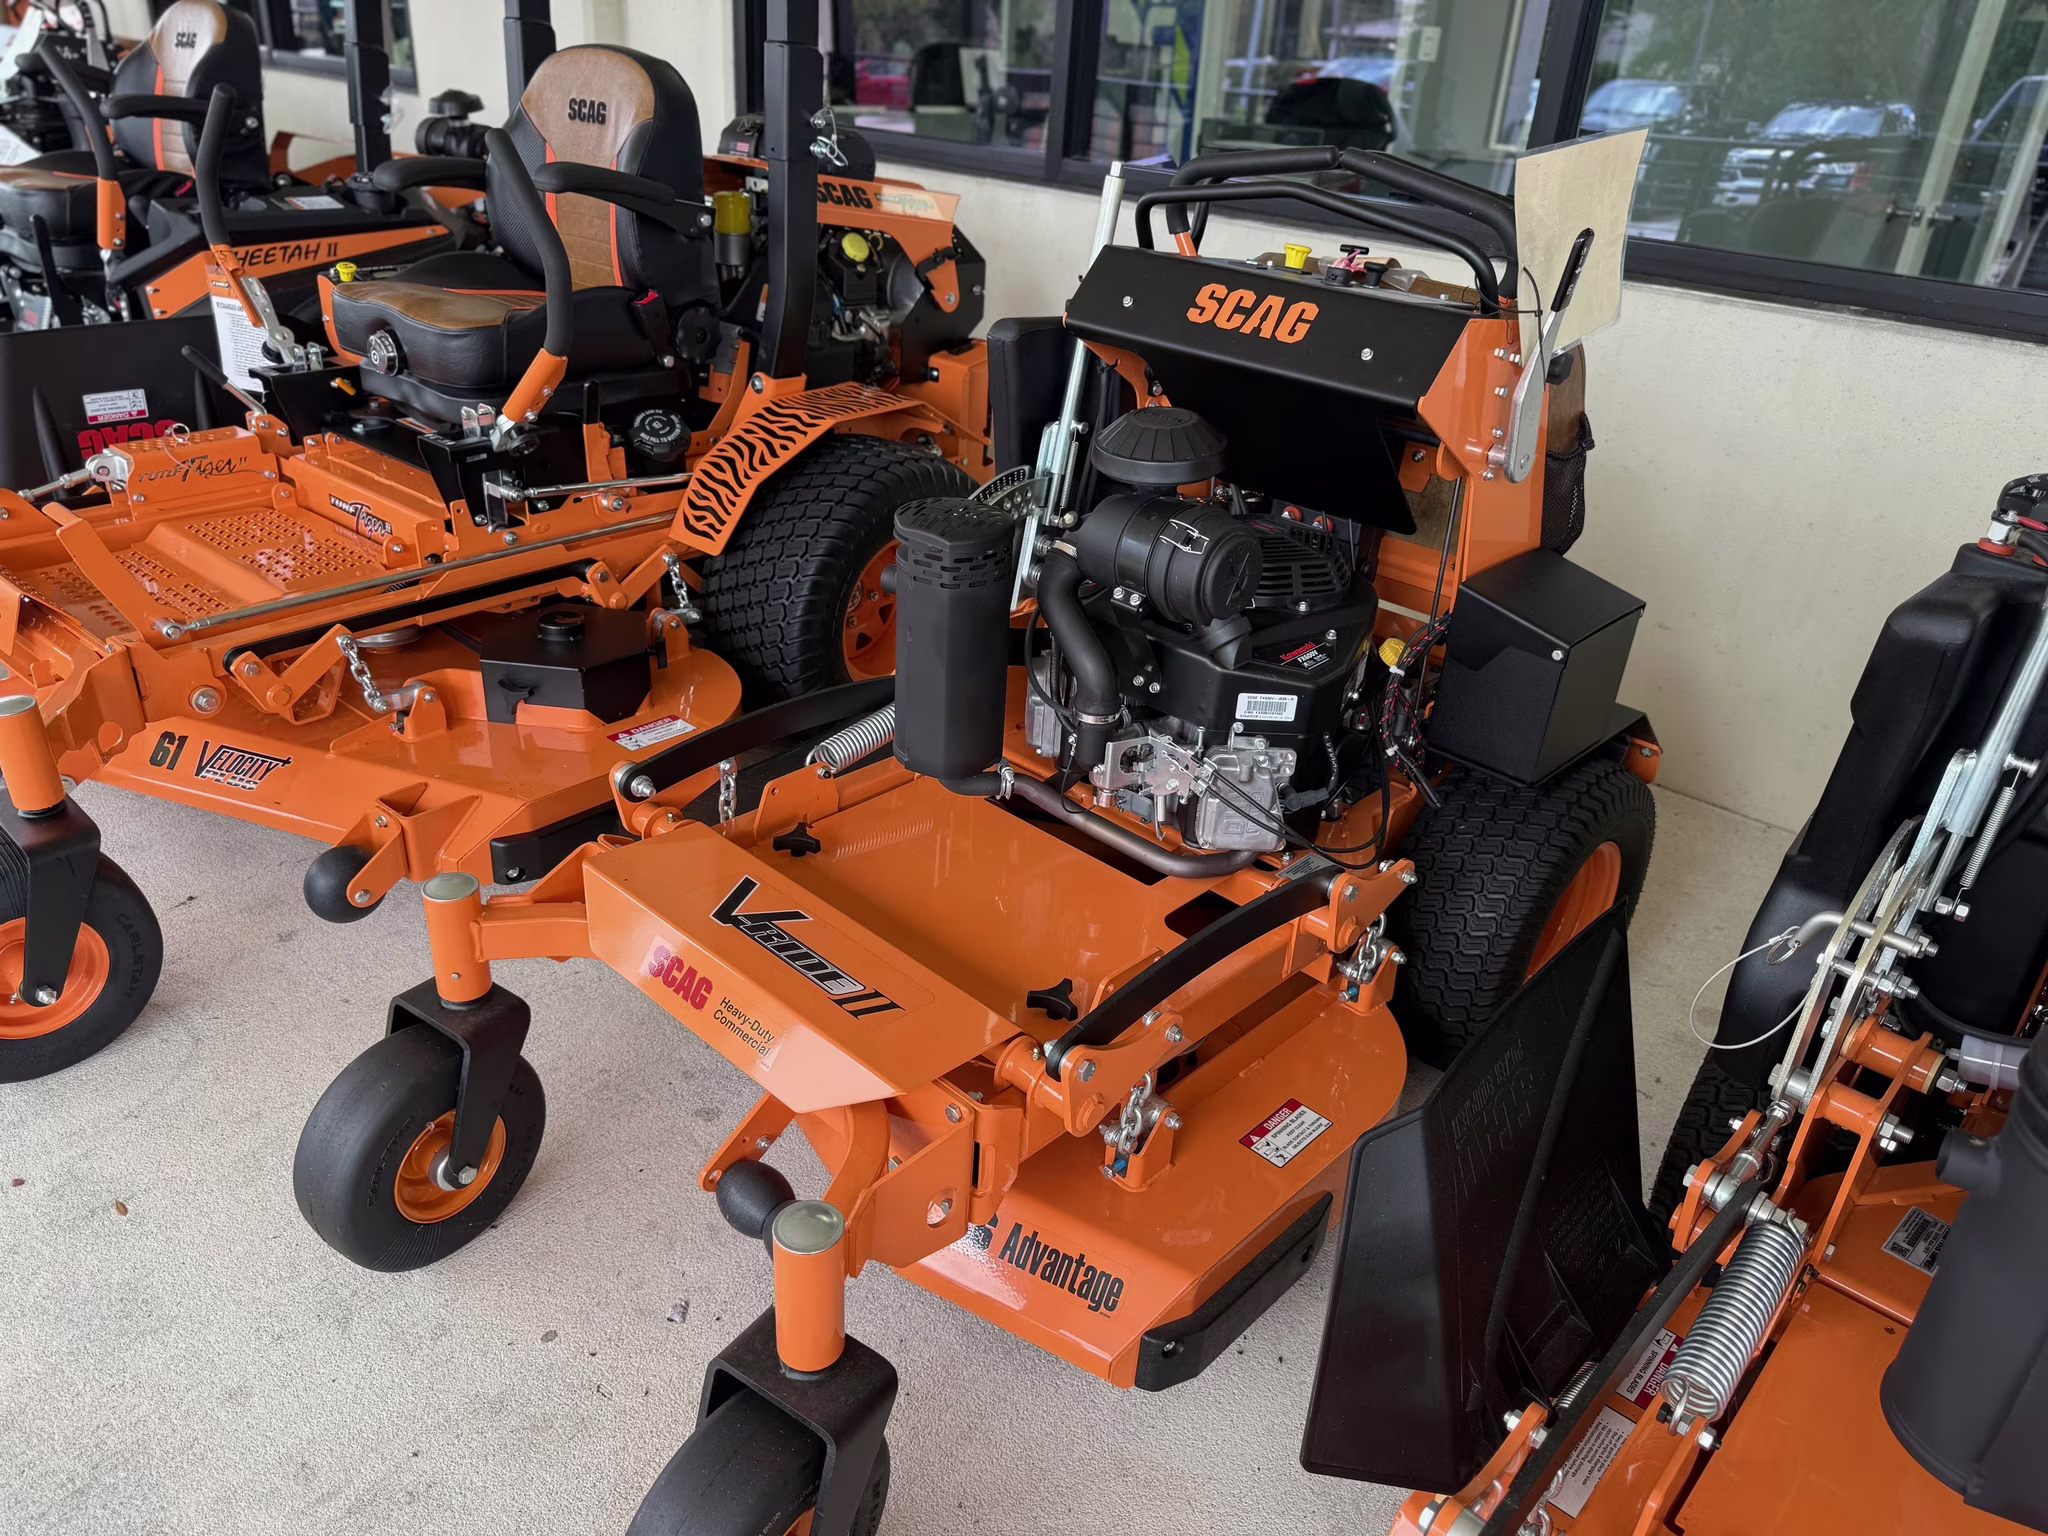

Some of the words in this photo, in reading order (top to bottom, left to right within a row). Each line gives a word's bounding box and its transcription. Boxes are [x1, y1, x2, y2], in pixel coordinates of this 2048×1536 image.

[567, 97, 607, 125] SCAG
[234, 242, 321, 271] HEETAH
[1186, 283, 1320, 344] SCAG
[97, 411, 130, 422] DANGER
[1280, 641, 1316, 661] Kawasaki
[629, 717, 674, 734] DANGER
[149, 731, 189, 771] 61
[194, 740, 293, 781] VELOCITY
[200, 769, 259, 791] PLUS
[647, 945, 713, 1011] SCAG
[827, 987, 906, 1020] II
[713, 1009, 771, 1058] Commercial
[719, 996, 775, 1045] Heavy-Duty
[1262, 1107, 1292, 1130] DANGER
[1270, 1121, 1291, 1139] SPINNING
[1289, 1109, 1306, 1123] BLADES
[998, 1222, 1125, 1313] Advantage
[1638, 1349, 1658, 1374] SPINNING
[1625, 1372, 1644, 1394] BLADES
[1643, 1361, 1669, 1397] DANGER
